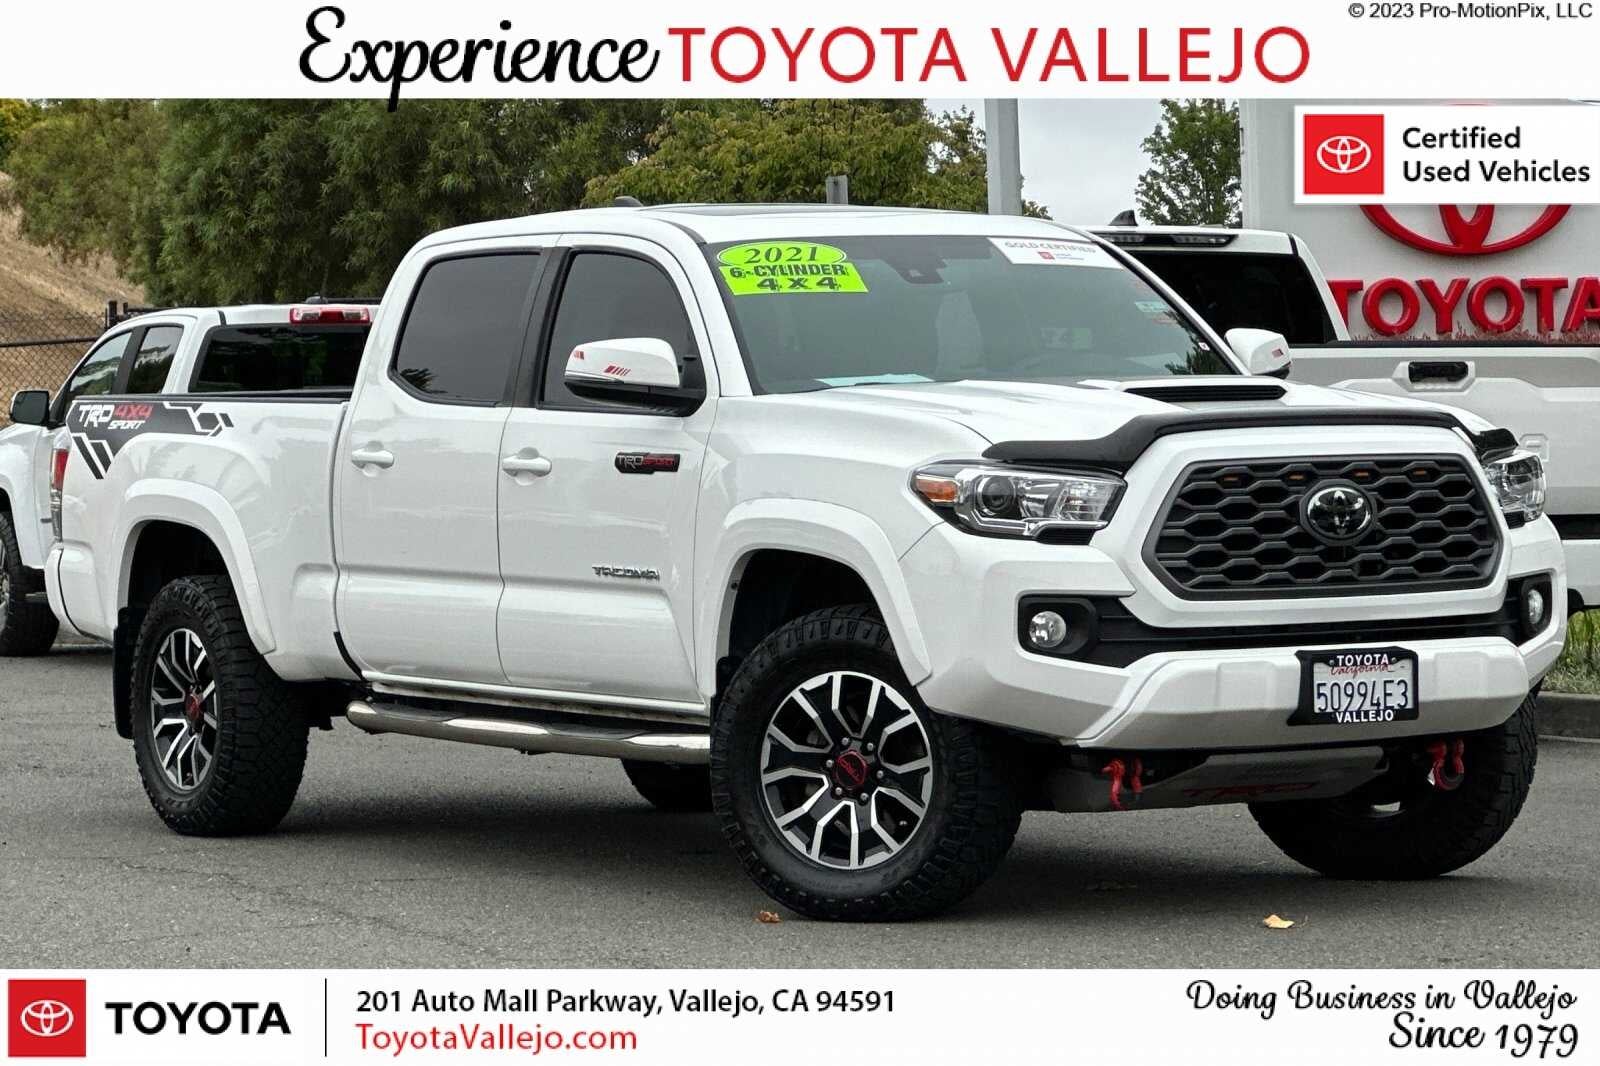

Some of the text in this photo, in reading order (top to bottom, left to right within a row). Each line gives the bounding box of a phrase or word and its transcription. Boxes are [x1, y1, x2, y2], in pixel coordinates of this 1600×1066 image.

[744, 246, 818, 264] 2021
[78, 404, 115, 428] TRD
[107, 420, 146, 430] SPORT
[616, 454, 644, 469] TRD
[1336, 653, 1389, 667] TOYOTA
[1316, 680, 1409, 712] 50994E3
[1335, 709, 1394, 723] VALLEJO
